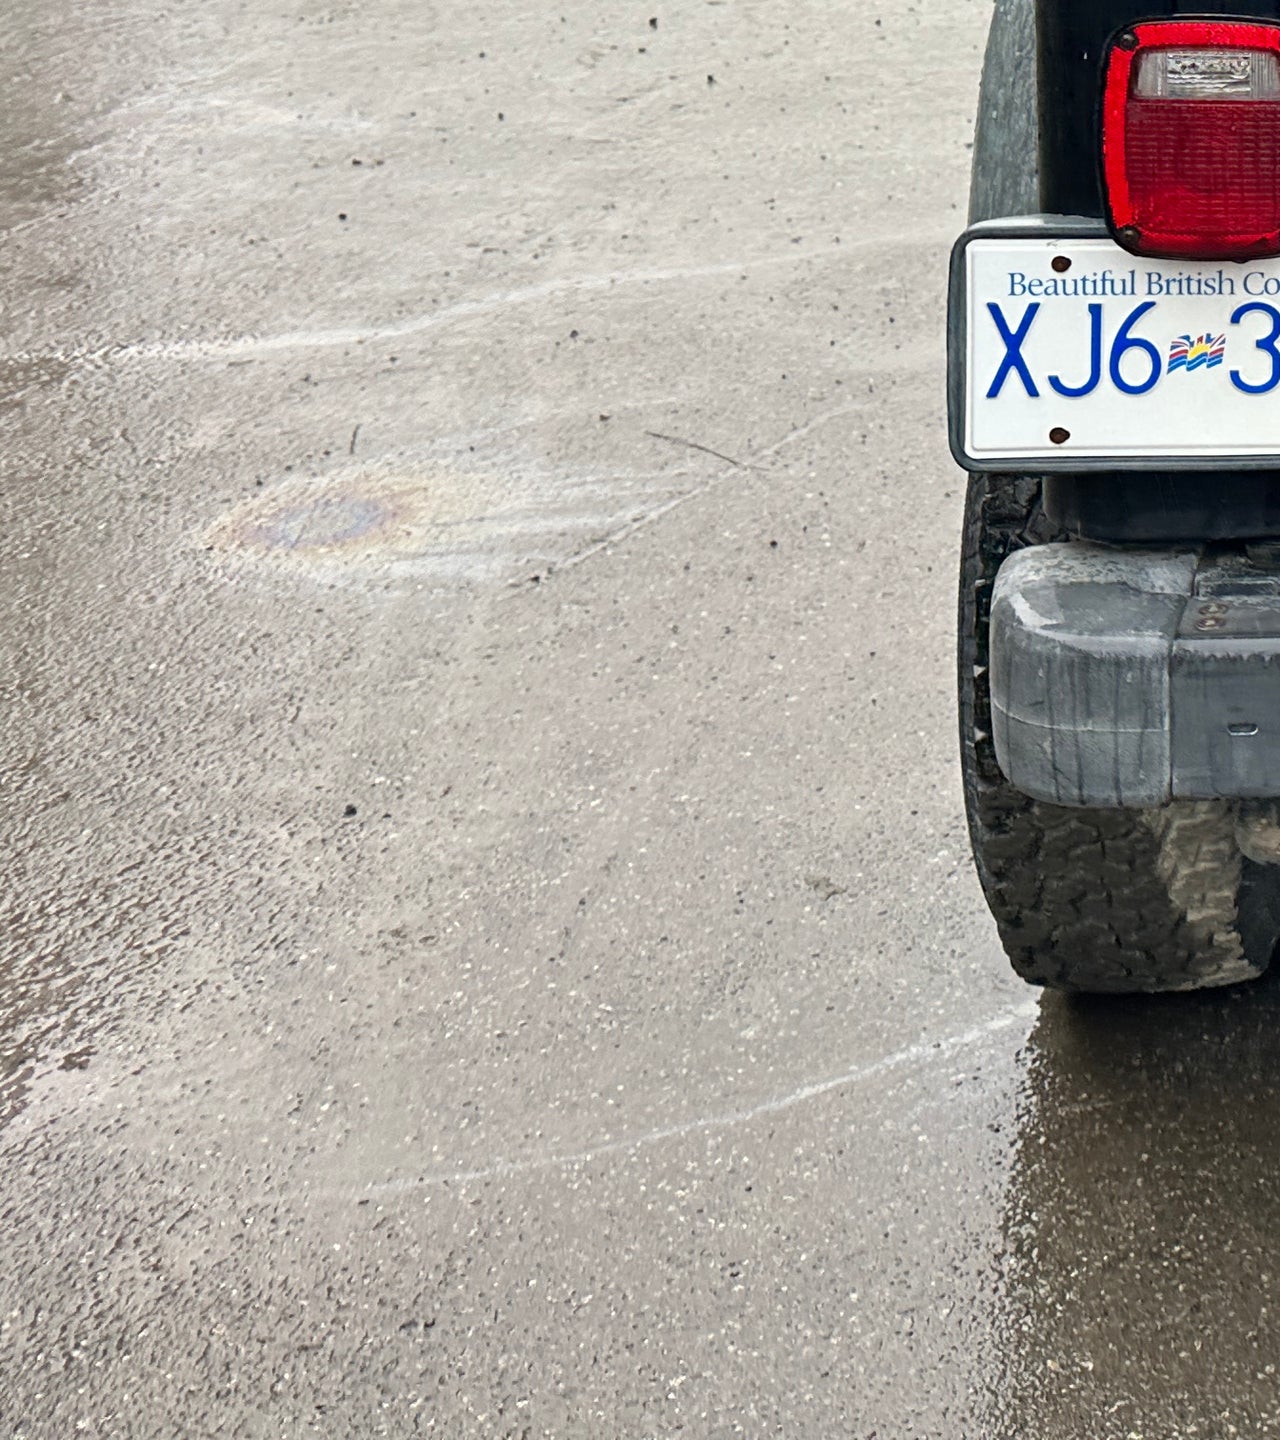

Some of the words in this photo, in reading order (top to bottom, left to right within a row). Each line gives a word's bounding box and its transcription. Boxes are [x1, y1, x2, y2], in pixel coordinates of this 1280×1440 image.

[1008, 270, 1136, 297] Beautiful
[1145, 271, 1235, 297] British
[985, 301, 1163, 399] XJ6
